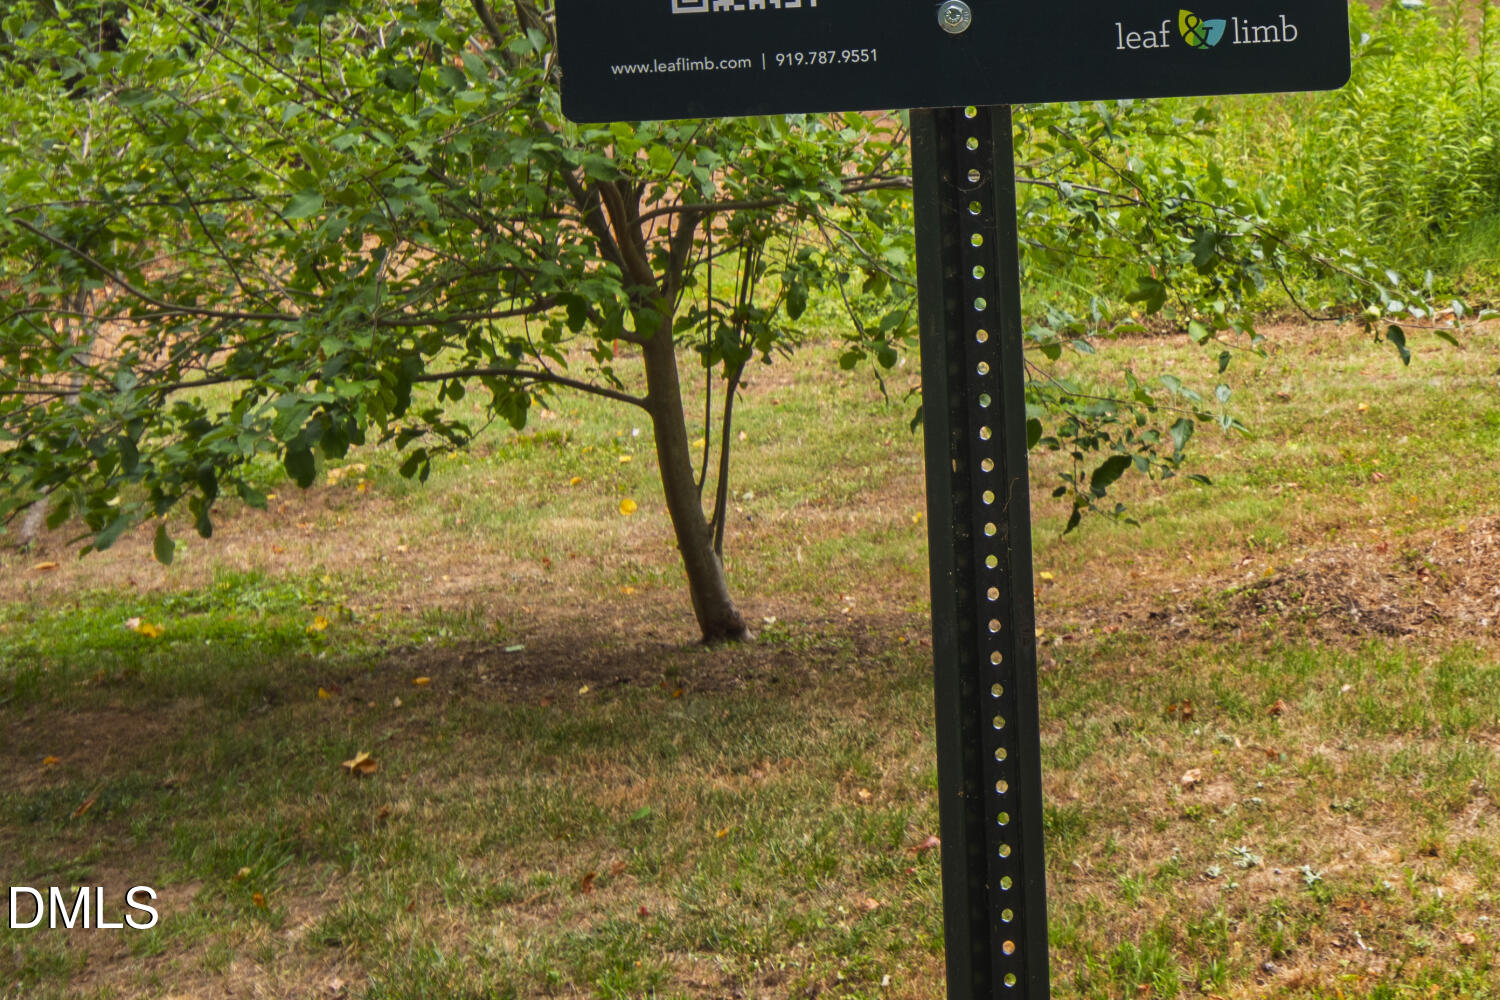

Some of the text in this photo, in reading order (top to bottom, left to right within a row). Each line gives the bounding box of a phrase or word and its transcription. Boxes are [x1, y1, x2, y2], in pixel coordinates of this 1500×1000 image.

[1114, 19, 1171, 50] leaf
[1231, 14, 1298, 45] limb
[610, 56, 752, 75] www.leaflimb.com
[775, 47, 877, 67] 919.787.9551
